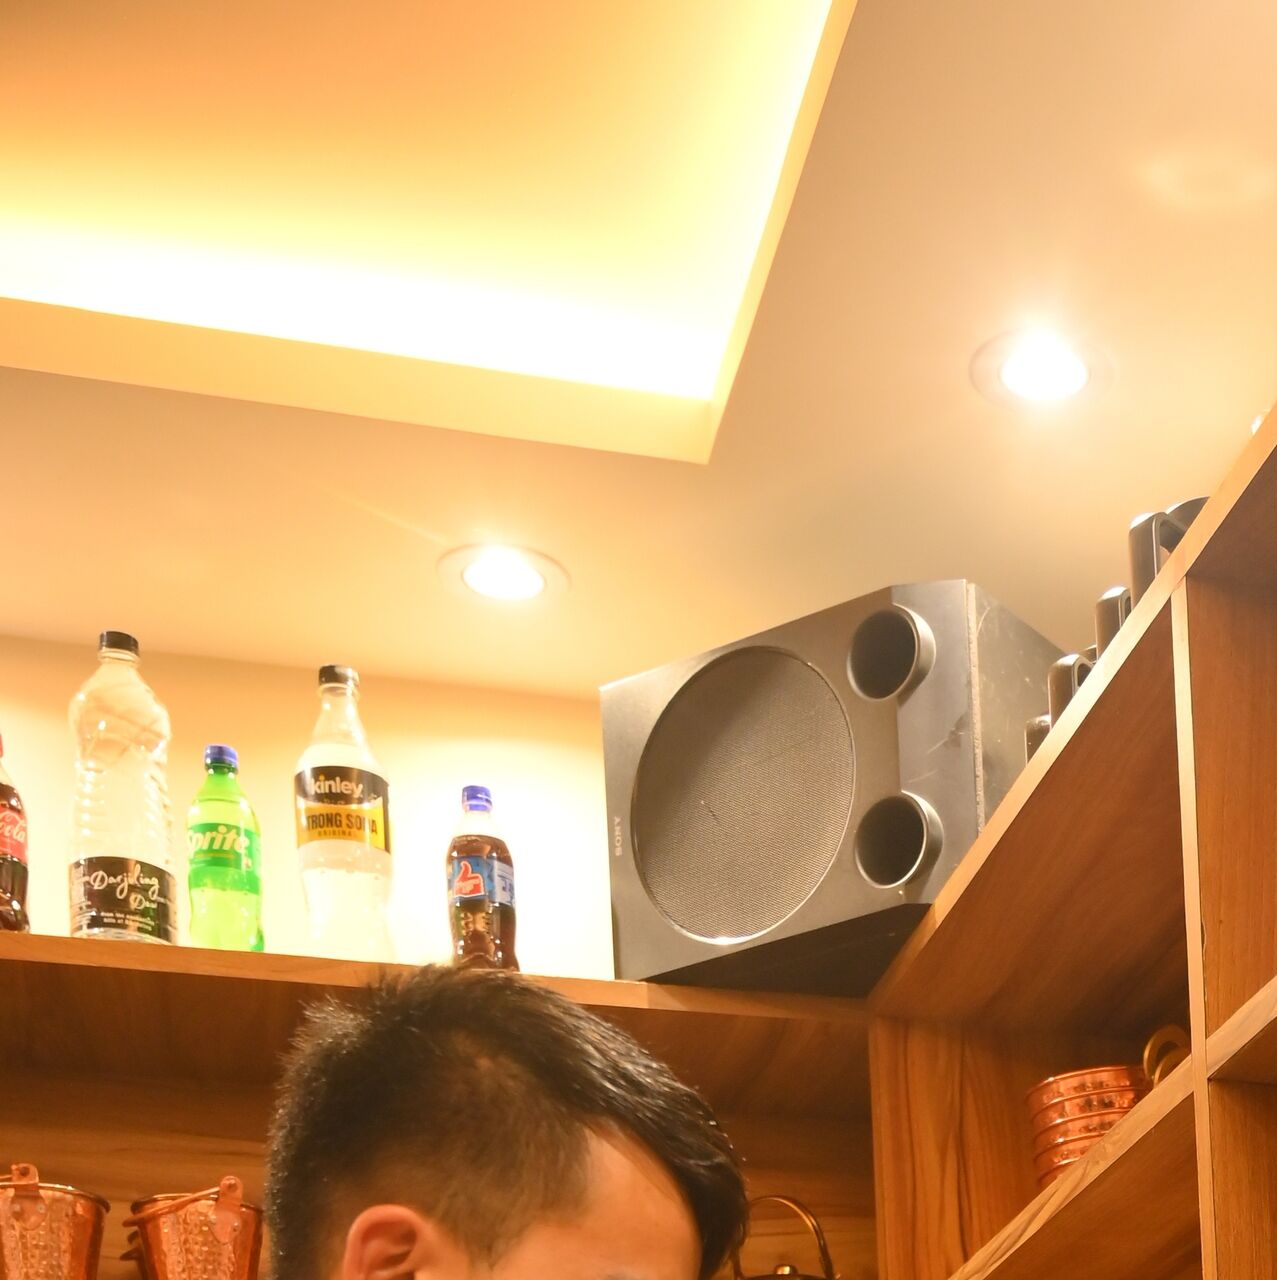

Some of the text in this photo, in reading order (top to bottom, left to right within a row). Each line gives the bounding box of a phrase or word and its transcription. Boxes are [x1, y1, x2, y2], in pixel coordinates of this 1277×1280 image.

[310, 774, 363, 799] kinley
[306, 812, 343, 832] TRONG
[614, 816, 623, 857] SONY
